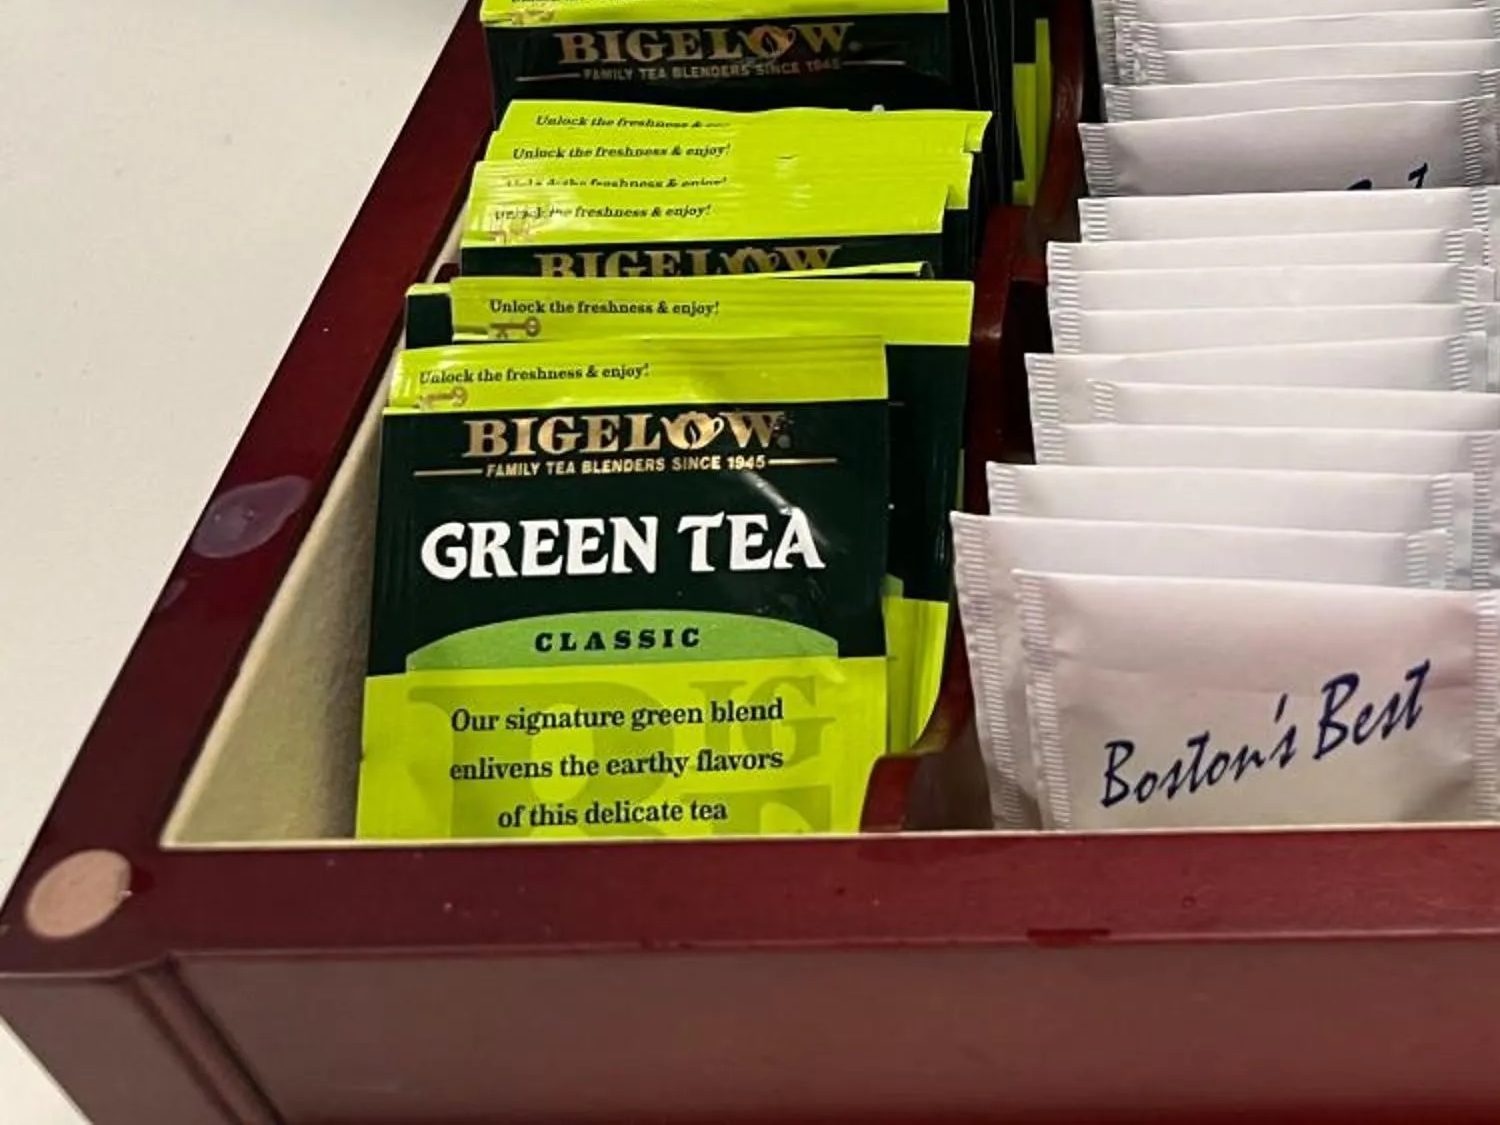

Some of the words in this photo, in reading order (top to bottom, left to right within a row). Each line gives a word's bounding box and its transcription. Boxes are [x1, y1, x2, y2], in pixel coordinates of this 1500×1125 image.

[553, 22, 857, 64] BIGELOW
[591, 117, 614, 126] the
[513, 148, 565, 159] Unlock
[569, 147, 593, 157] the
[595, 146, 667, 157] freshness
[686, 144, 731, 157] enjoy!
[575, 207, 652, 218] freshness
[666, 205, 711, 218] enjoy!
[490, 299, 545, 313] Unlock
[550, 300, 574, 313] the
[578, 300, 653, 313] freshness
[657, 301, 669, 312] &
[672, 301, 719, 317] enjoy!
[420, 369, 474, 383] Unlock
[478, 369, 502, 382] the
[507, 368, 583, 380] freshness
[586, 365, 598, 377] &
[601, 363, 649, 379] enjoy!
[461, 411, 785, 457] BIGELOW
[485, 463, 539, 477] FAMILY
[546, 461, 576, 474] TEA
[582, 458, 665, 474] BLENDERS
[671, 456, 721, 471] SINCE
[727, 454, 766, 470] 1945
[420, 516, 659, 579] GREEN
[676, 507, 826, 574] TEA
[534, 627, 701, 653] CLASSIC
[451, 708, 499, 732] Our
[505, 704, 625, 735] signature
[630, 704, 703, 732] green
[710, 698, 784, 724] blend
[1101, 693, 1297, 807] Boston's
[1311, 660, 1431, 760] Best
[450, 755, 554, 780] enlivens
[560, 754, 600, 778] the
[605, 752, 687, 780] earthy
[696, 748, 784, 772] flavors
[497, 804, 524, 829] of
[528, 803, 579, 827] this
[584, 802, 684, 825] delicate
[690, 802, 728, 821] tea
